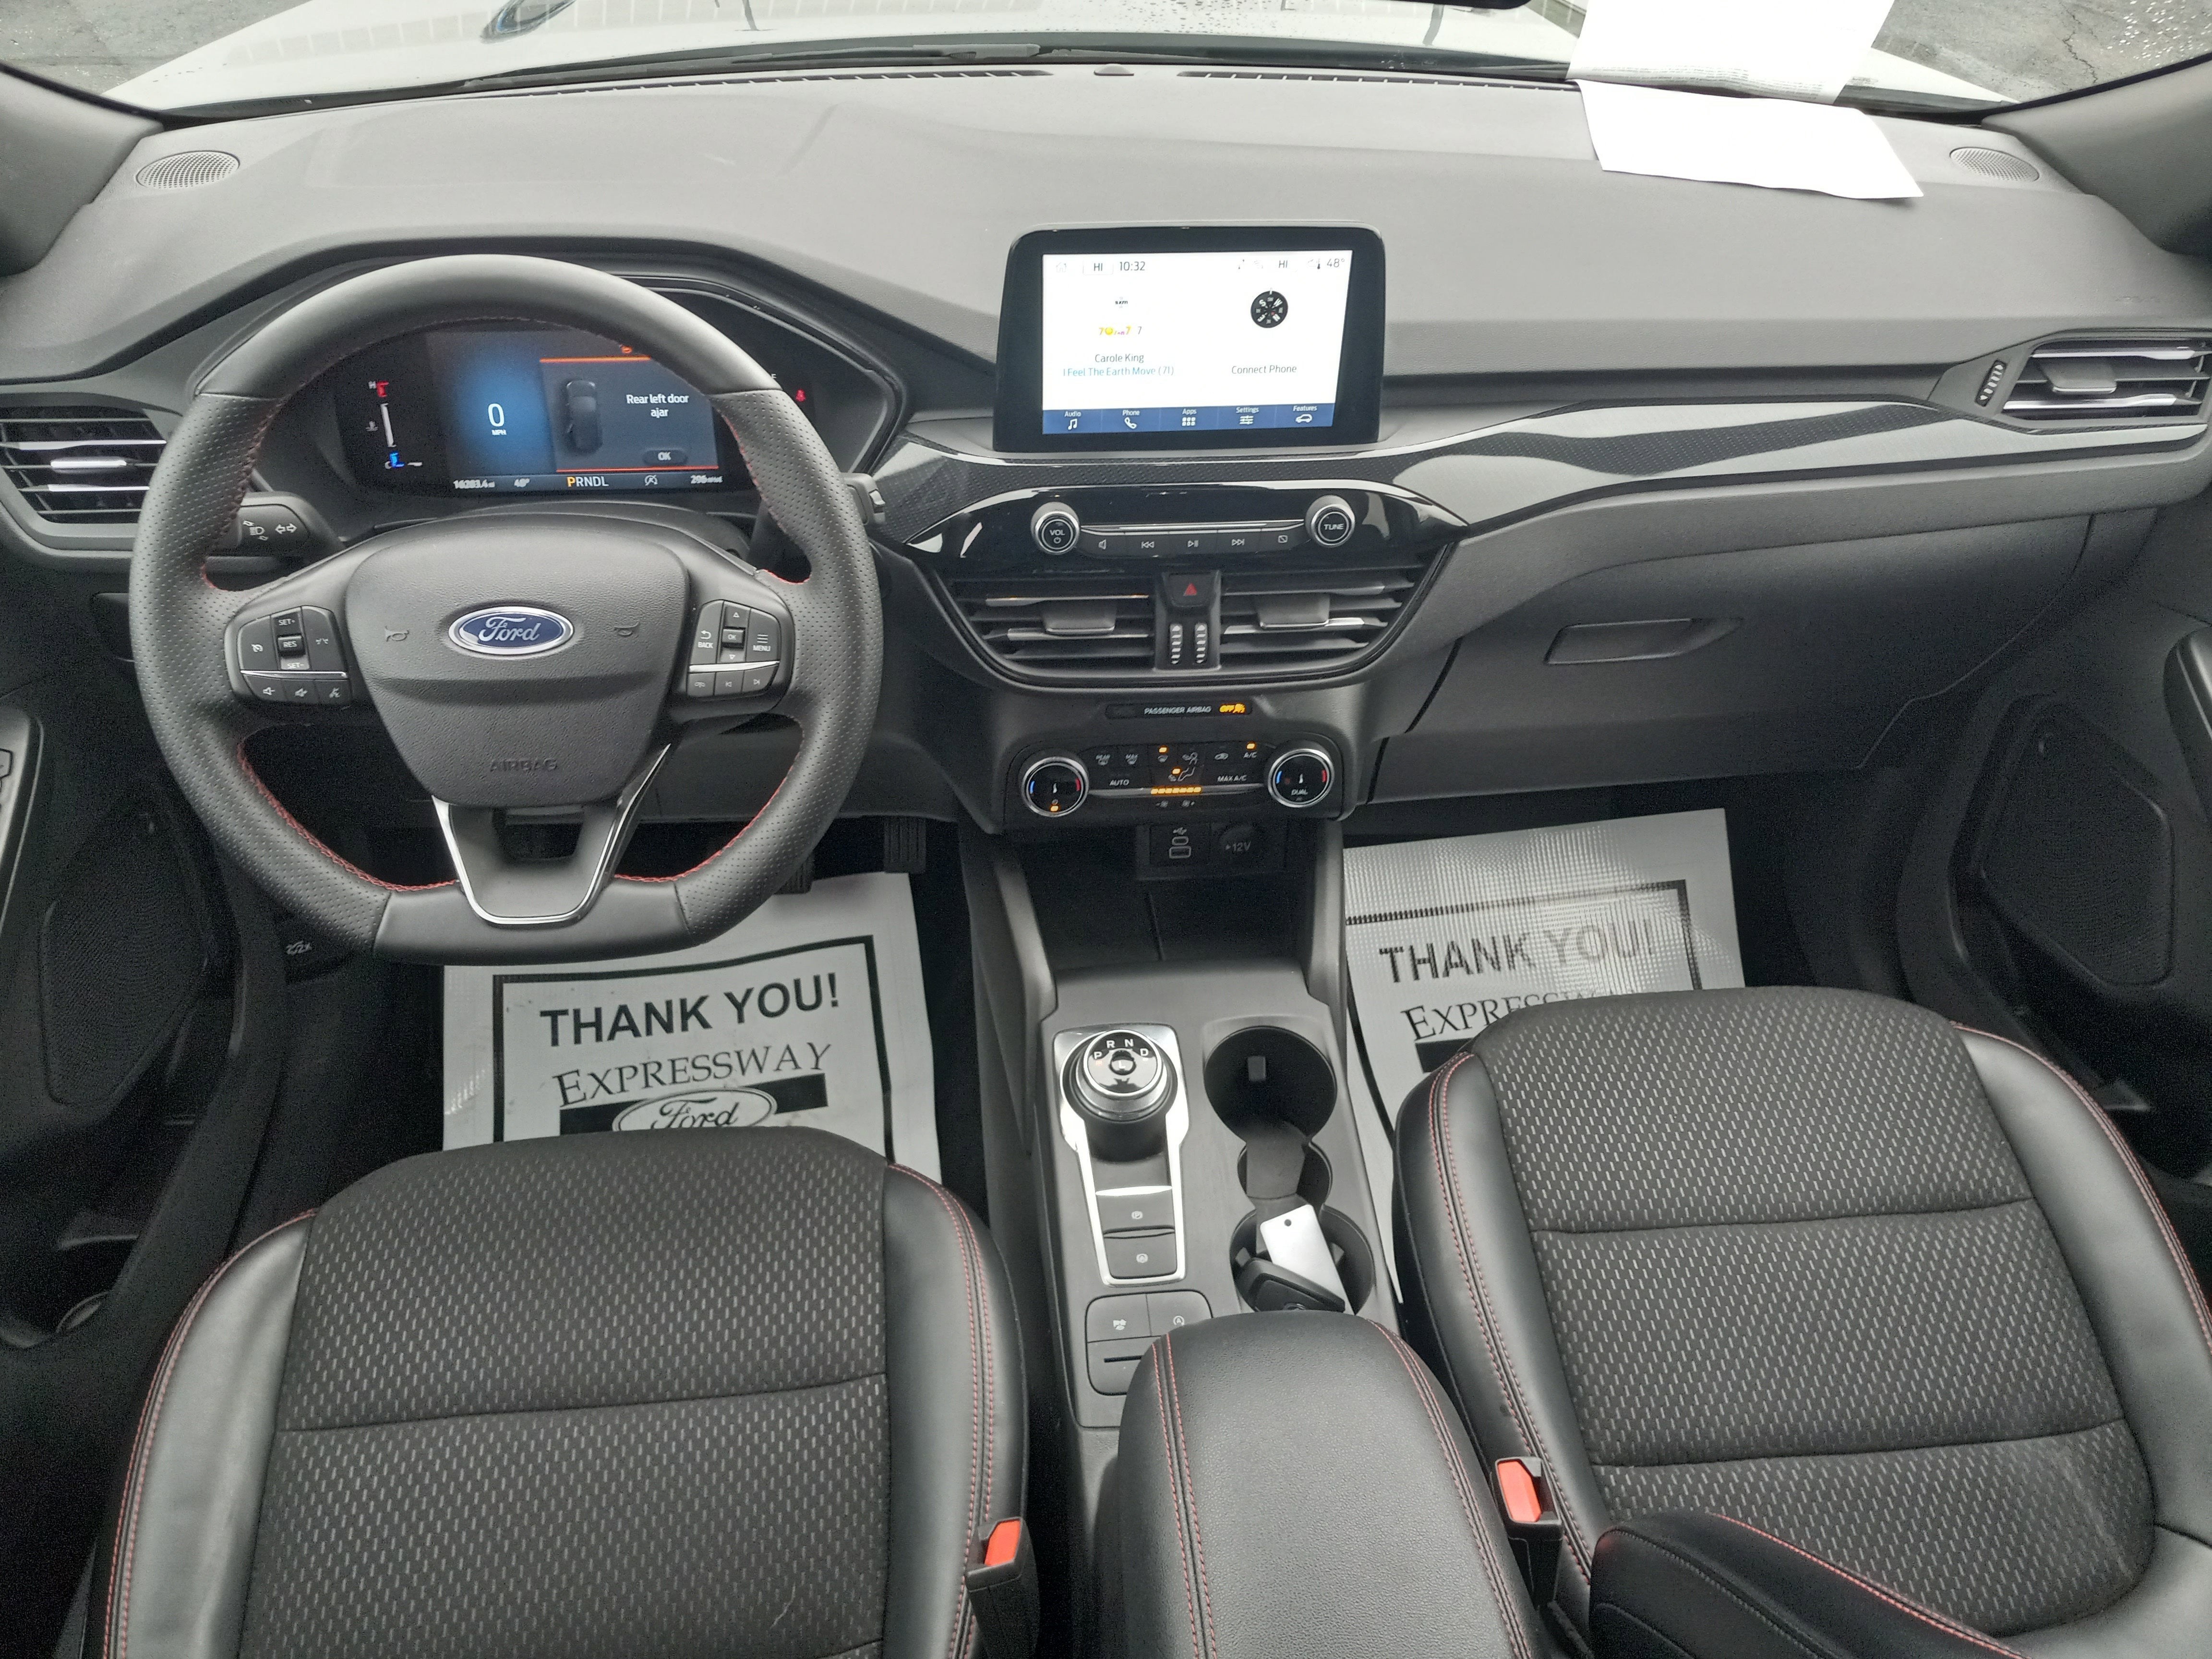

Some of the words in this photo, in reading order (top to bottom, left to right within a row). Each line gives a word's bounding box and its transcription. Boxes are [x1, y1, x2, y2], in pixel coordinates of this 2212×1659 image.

[1094, 263, 1103, 271] HI
[1119, 261, 1146, 271] 10:32
[1279, 260, 1288, 268] HI
[1095, 354, 1122, 363] Carole
[1125, 353, 1144, 363] King
[1068, 368, 1085, 376] Feel
[1089, 368, 1104, 376] The
[1106, 367, 1130, 376] Earth
[1132, 367, 1155, 375] Move
[1232, 365, 1267, 374] Connect
[1269, 365, 1297, 373] Phone
[626, 394, 649, 404] Rear
[649, 394, 666, 404] left
[667, 394, 689, 403] door
[488, 403, 505, 427] 0
[650, 408, 669, 419] ajar
[658, 452, 672, 461] OK
[566, 476, 609, 488] PRNDL
[479, 616, 541, 641] Ford
[1144, 707, 1185, 715] PASSENGER
[490, 758, 558, 771] AIRBAG
[1379, 930, 1537, 983] THANK
[1546, 918, 1653, 962] YOU!
[540, 995, 712, 1047] THANK
[724, 973, 839, 1024] YOU!
[1106, 1040, 1115, 1048] R
[1124, 1038, 1134, 1047] N
[1094, 1051, 1103, 1060] P
[1140, 1048, 1149, 1057] D
[553, 1042, 832, 1107] EXPRESSWAY
